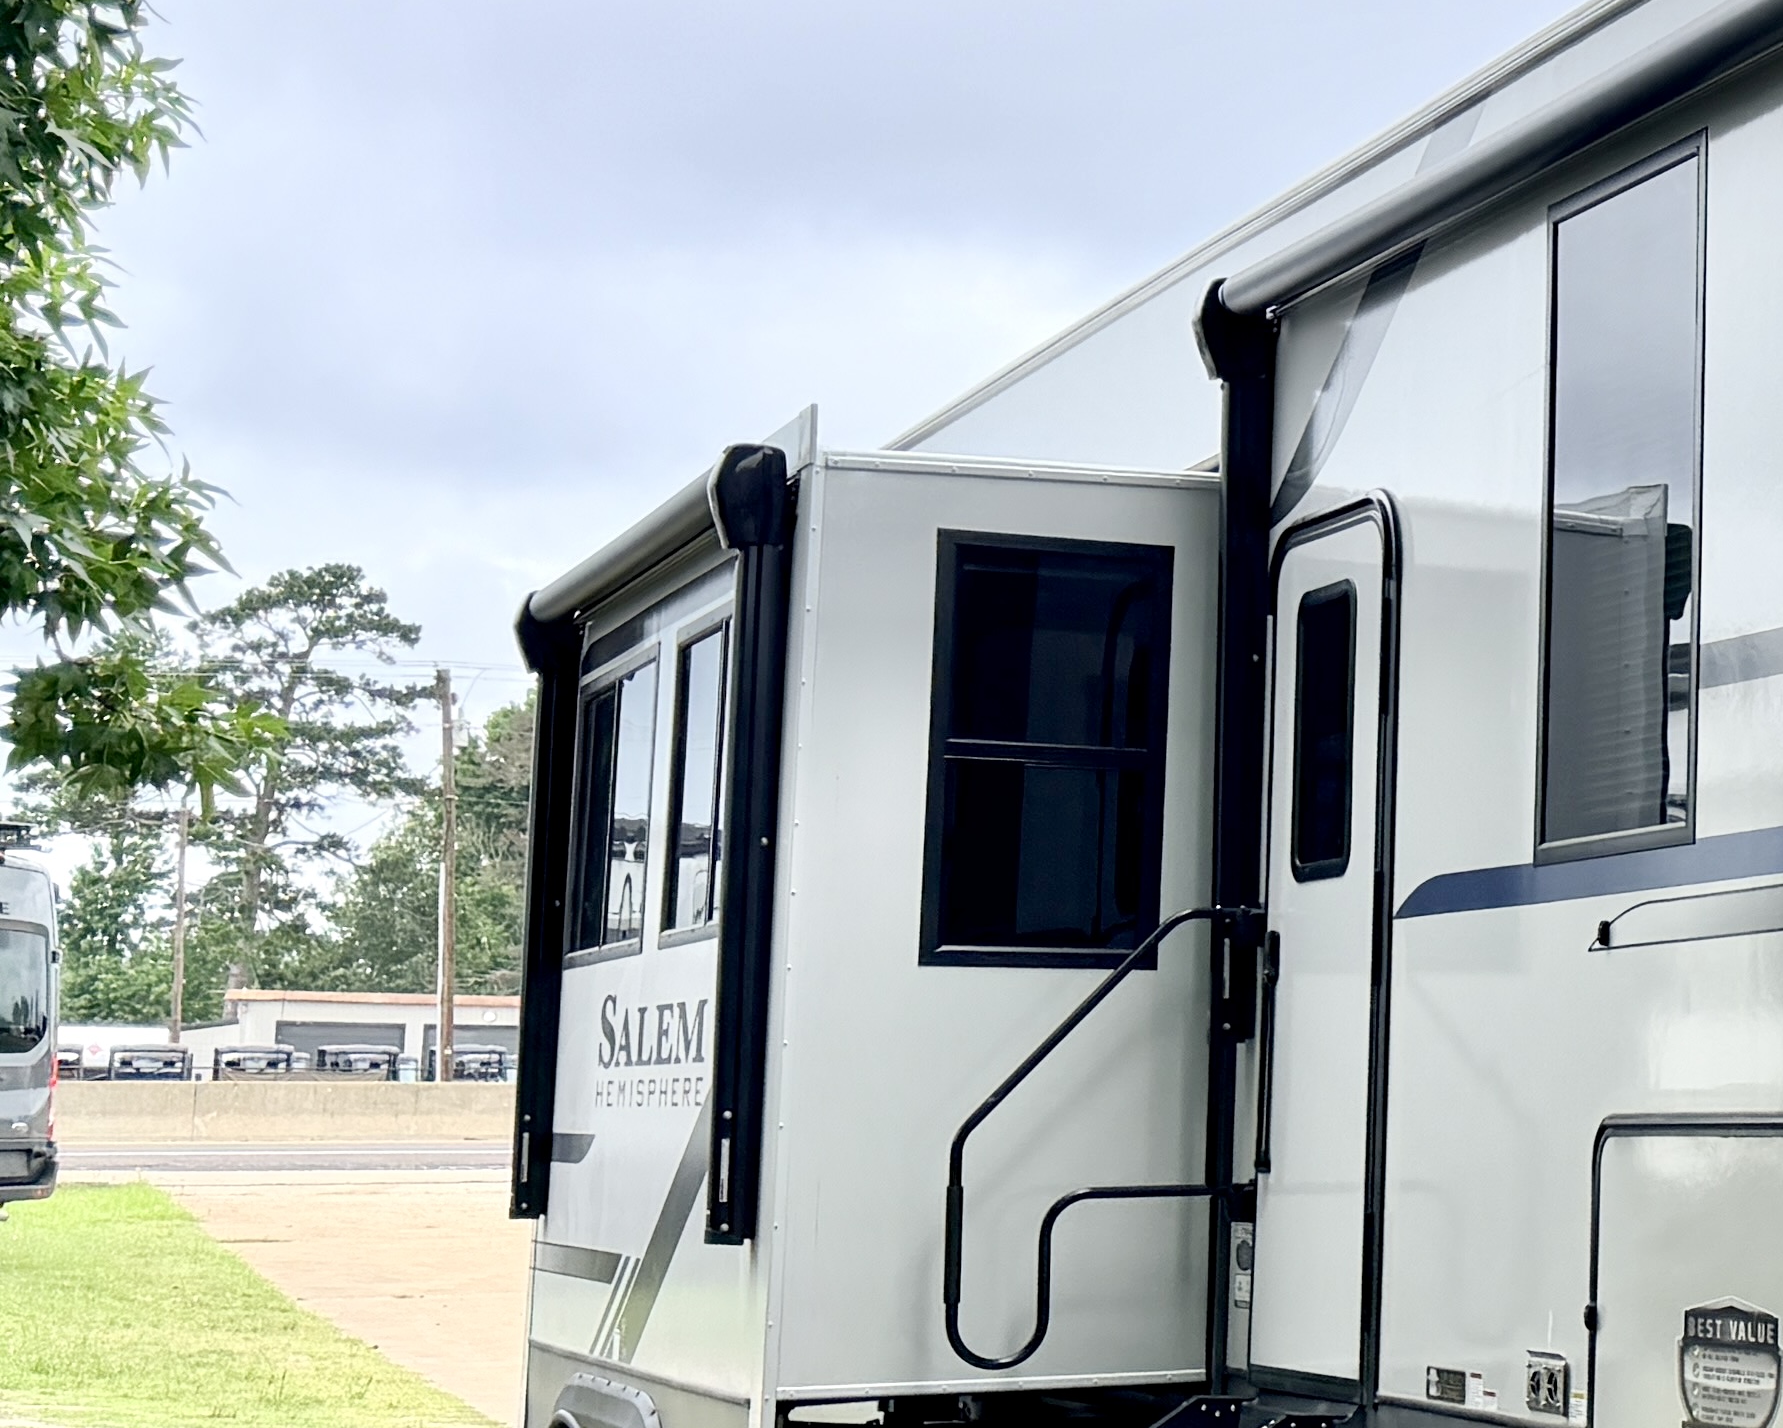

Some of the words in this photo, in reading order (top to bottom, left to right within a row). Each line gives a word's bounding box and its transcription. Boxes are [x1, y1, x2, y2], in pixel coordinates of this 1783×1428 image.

[598, 994, 708, 1069] SALEM
[594, 1076, 704, 1107] HEMISPHERE
[1687, 1316, 1722, 1339] BEST
[1729, 1320, 1775, 1344] VALUE
